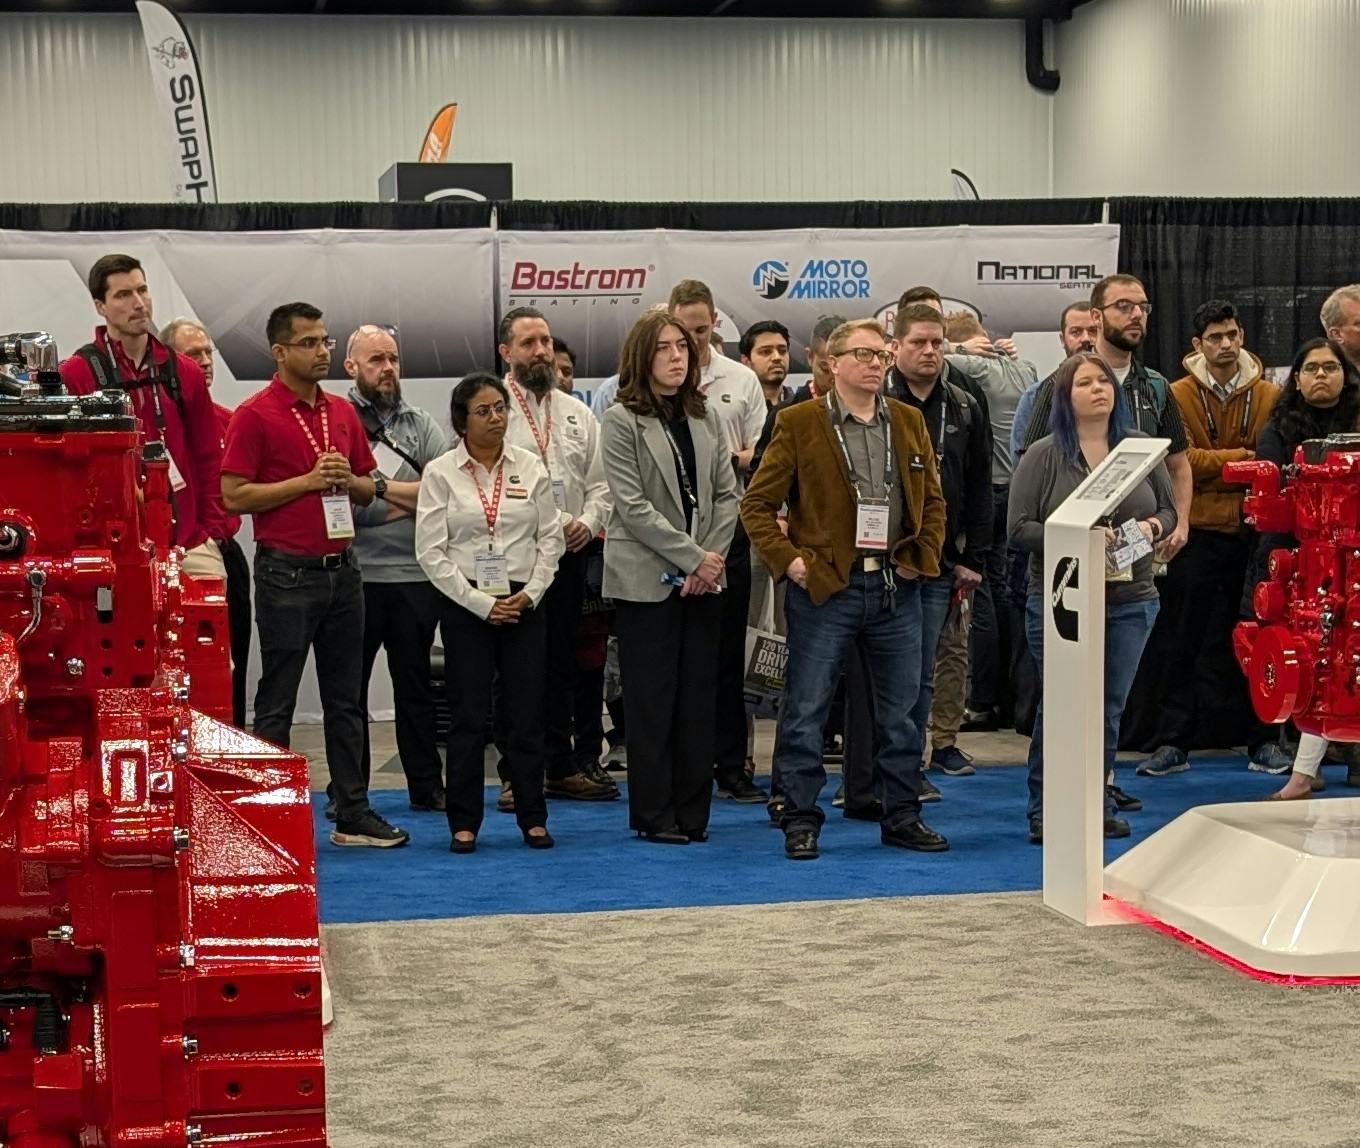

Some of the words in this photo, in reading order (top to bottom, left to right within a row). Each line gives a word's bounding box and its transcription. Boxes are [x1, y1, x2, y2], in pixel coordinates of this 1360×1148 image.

[511, 262, 646, 290] Bostrom
[800, 259, 868, 279] MOTO
[788, 279, 871, 299] MIRROR
